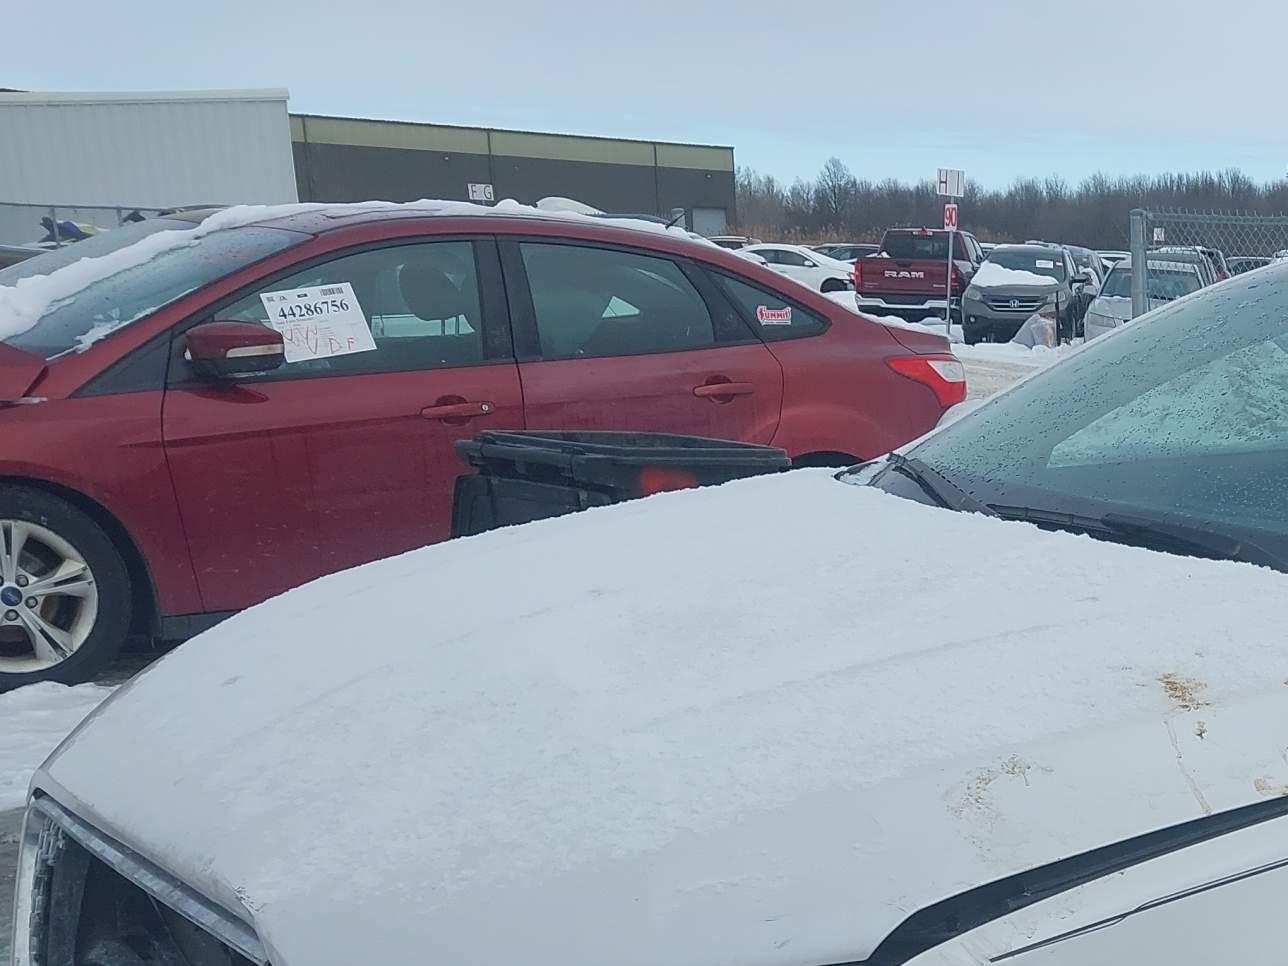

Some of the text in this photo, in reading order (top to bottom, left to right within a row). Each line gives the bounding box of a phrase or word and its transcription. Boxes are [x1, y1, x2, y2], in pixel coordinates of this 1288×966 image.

[938, 169, 948, 194] H
[471, 184, 492, 200] F G
[945, 207, 957, 227] 90
[884, 270, 925, 279] RAM
[278, 298, 350, 319] 44286756
